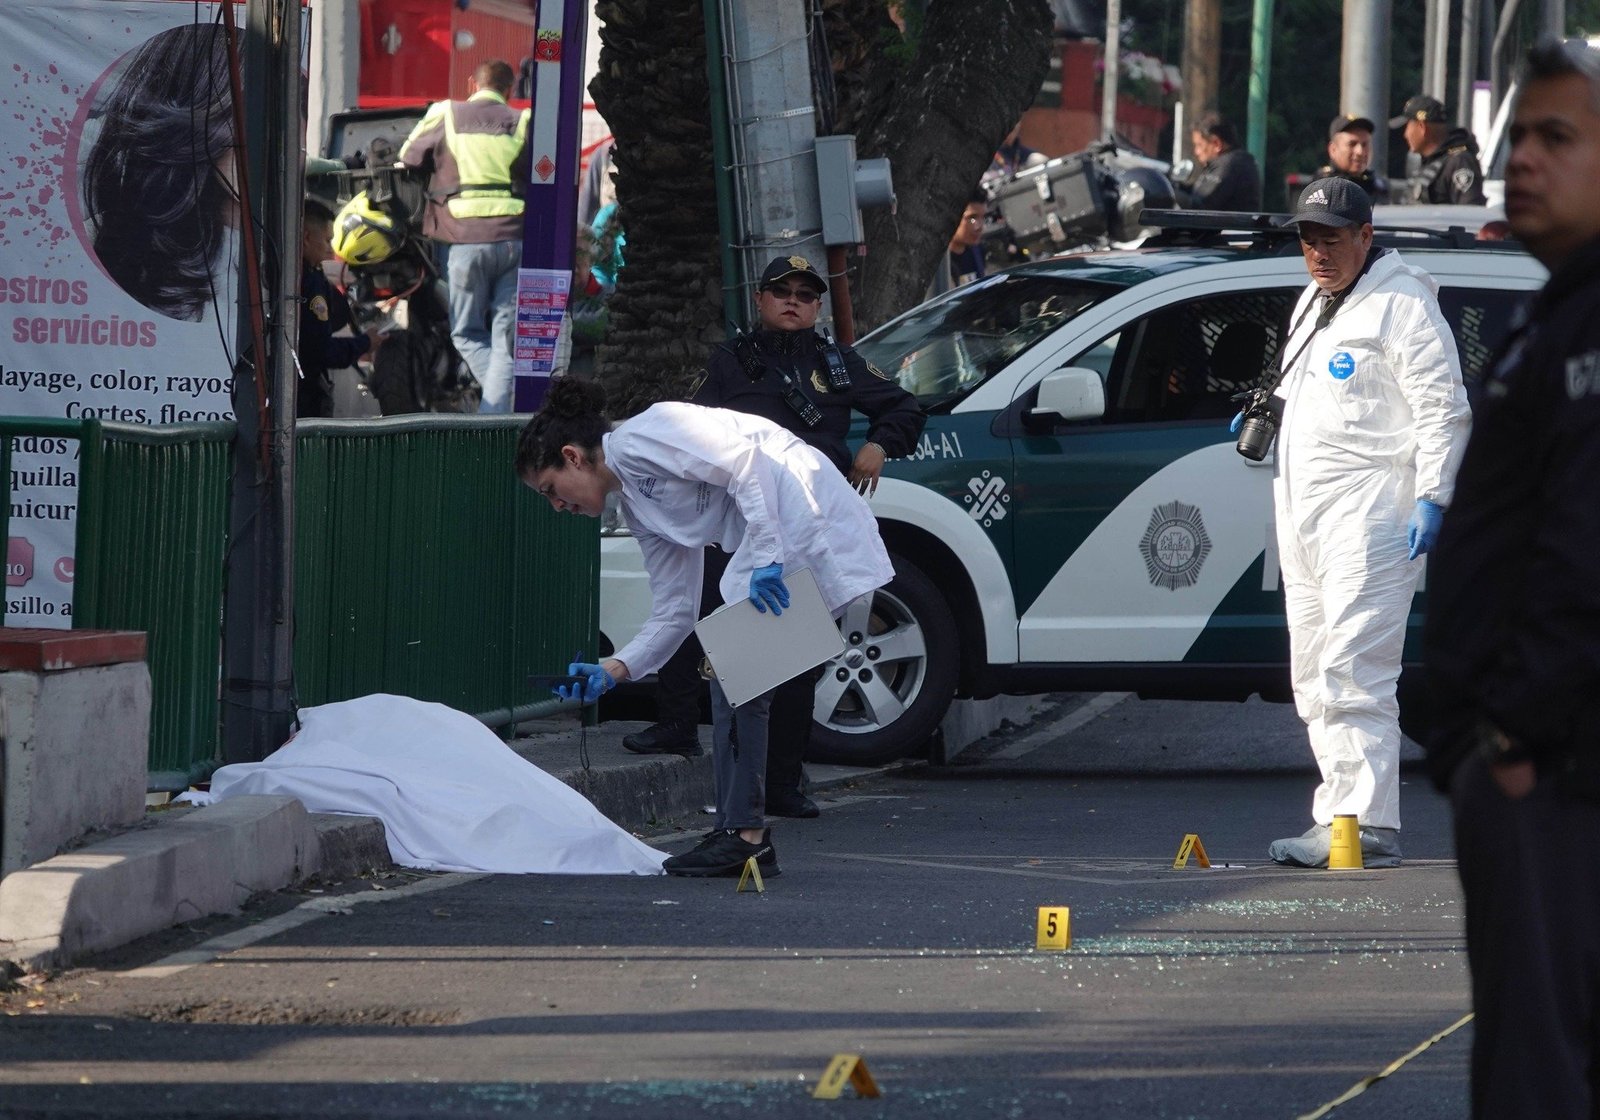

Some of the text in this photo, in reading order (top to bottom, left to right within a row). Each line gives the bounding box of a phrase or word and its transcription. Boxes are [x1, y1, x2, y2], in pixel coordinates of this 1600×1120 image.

[12, 313, 157, 347] servicios
[90, 369, 158, 394] color,
[166, 376, 235, 398] rayos
[1180, 839, 1190, 860] 2
[1047, 912, 1058, 938] 5
